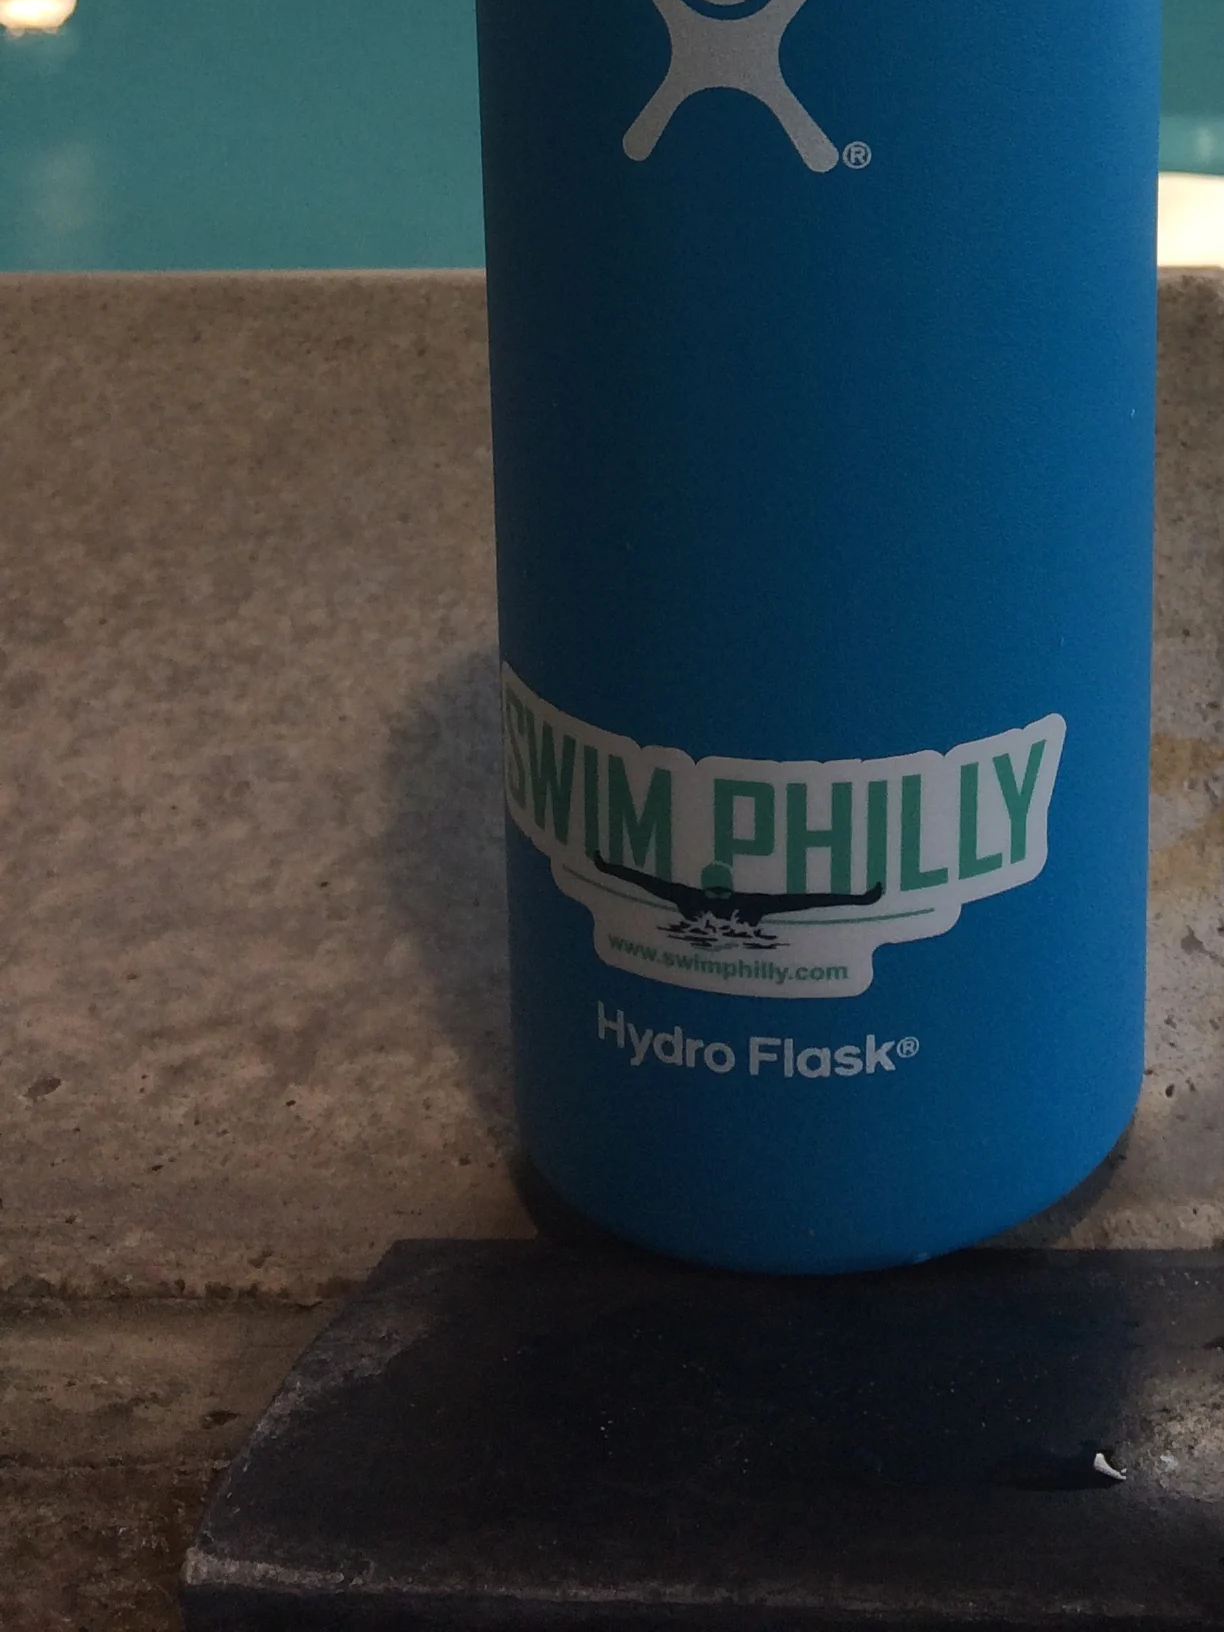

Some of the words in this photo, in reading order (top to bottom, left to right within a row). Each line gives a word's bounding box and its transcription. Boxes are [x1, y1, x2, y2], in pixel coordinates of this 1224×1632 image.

[504, 683, 672, 884] SWIM
[714, 739, 1047, 896] PHILLY
[608, 934, 849, 985] www.swimphilly.com
[598, 1001, 735, 1074] Hydro
